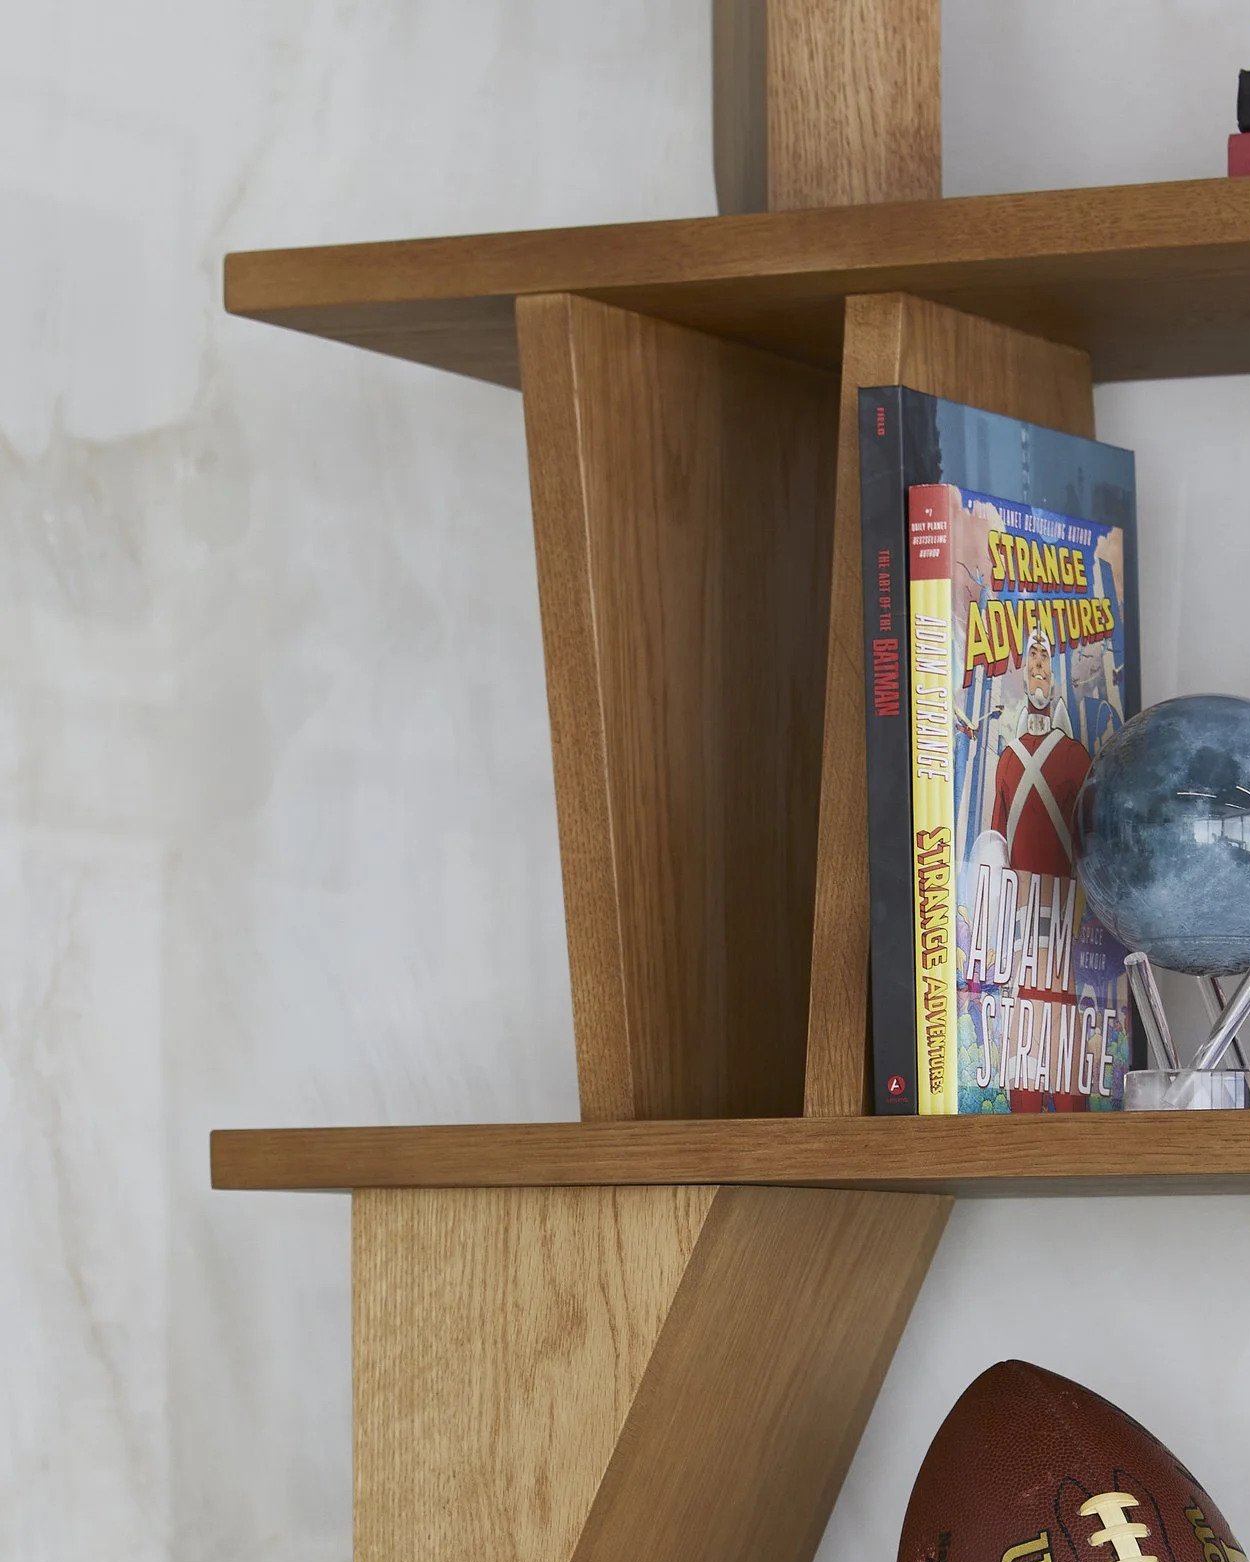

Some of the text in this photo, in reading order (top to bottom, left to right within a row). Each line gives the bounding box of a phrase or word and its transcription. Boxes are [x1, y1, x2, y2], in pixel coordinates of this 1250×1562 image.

[876, 407, 885, 436] FIELD
[911, 521, 947, 532] DAILY PLANET
[913, 535, 947, 545] BESTSELLING
[999, 507, 1022, 530] PLANET
[1024, 513, 1066, 540] BESTSELLING
[1068, 525, 1092, 546] AUTHOR
[919, 548, 940, 558] AUTHOR
[988, 530, 1088, 593] STRANGE
[873, 550, 900, 717] THE ART OF THE BATMAN
[963, 596, 1117, 686] ADVENTURES
[915, 614, 951, 782] ADAM STRANGE
[966, 863, 1077, 993] ADAM
[1081, 927, 1104, 946] SPACE
[916, 826, 952, 1096] STRANGE ADVENTURES
[1080, 951, 1106, 970] MEMOIR
[977, 992, 1117, 1096] STRANGE
